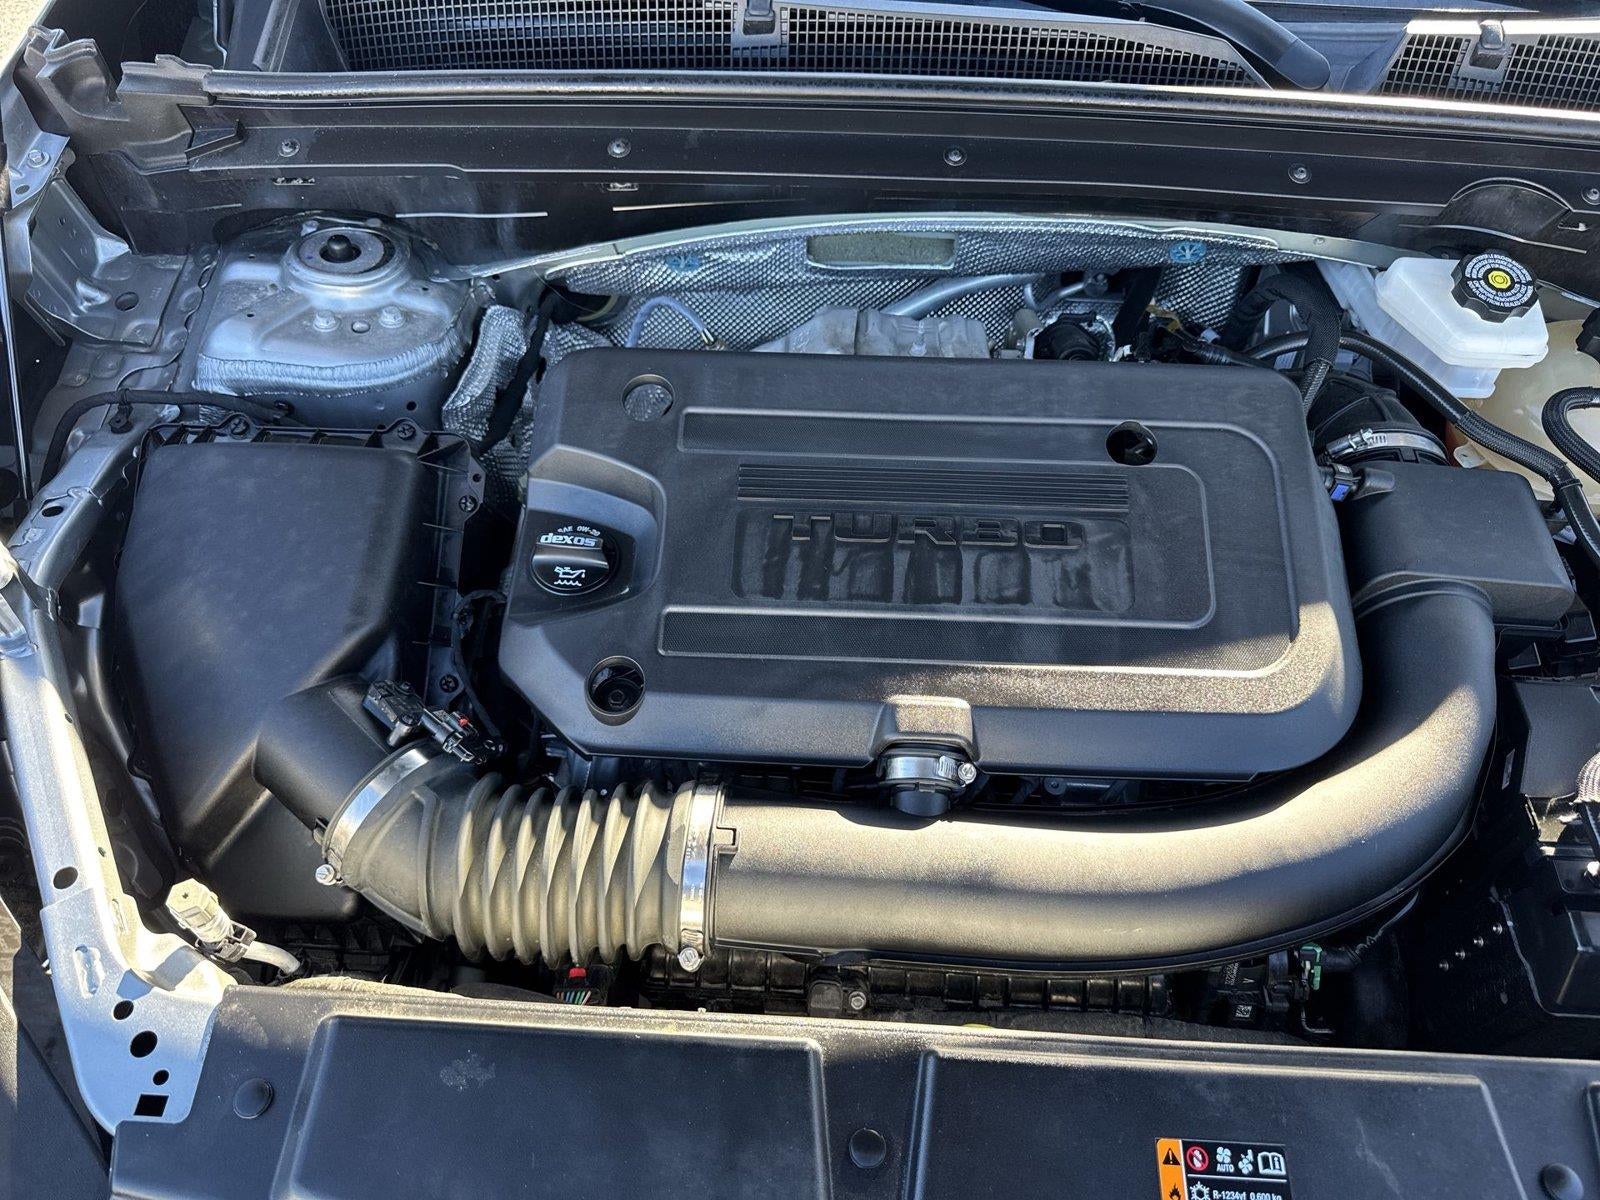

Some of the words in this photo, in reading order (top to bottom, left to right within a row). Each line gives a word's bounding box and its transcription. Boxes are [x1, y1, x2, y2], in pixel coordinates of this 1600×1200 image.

[773, 512, 1086, 550] TURBO
[540, 533, 597, 547] dexos
[1216, 1163, 1235, 1173] AUTO
